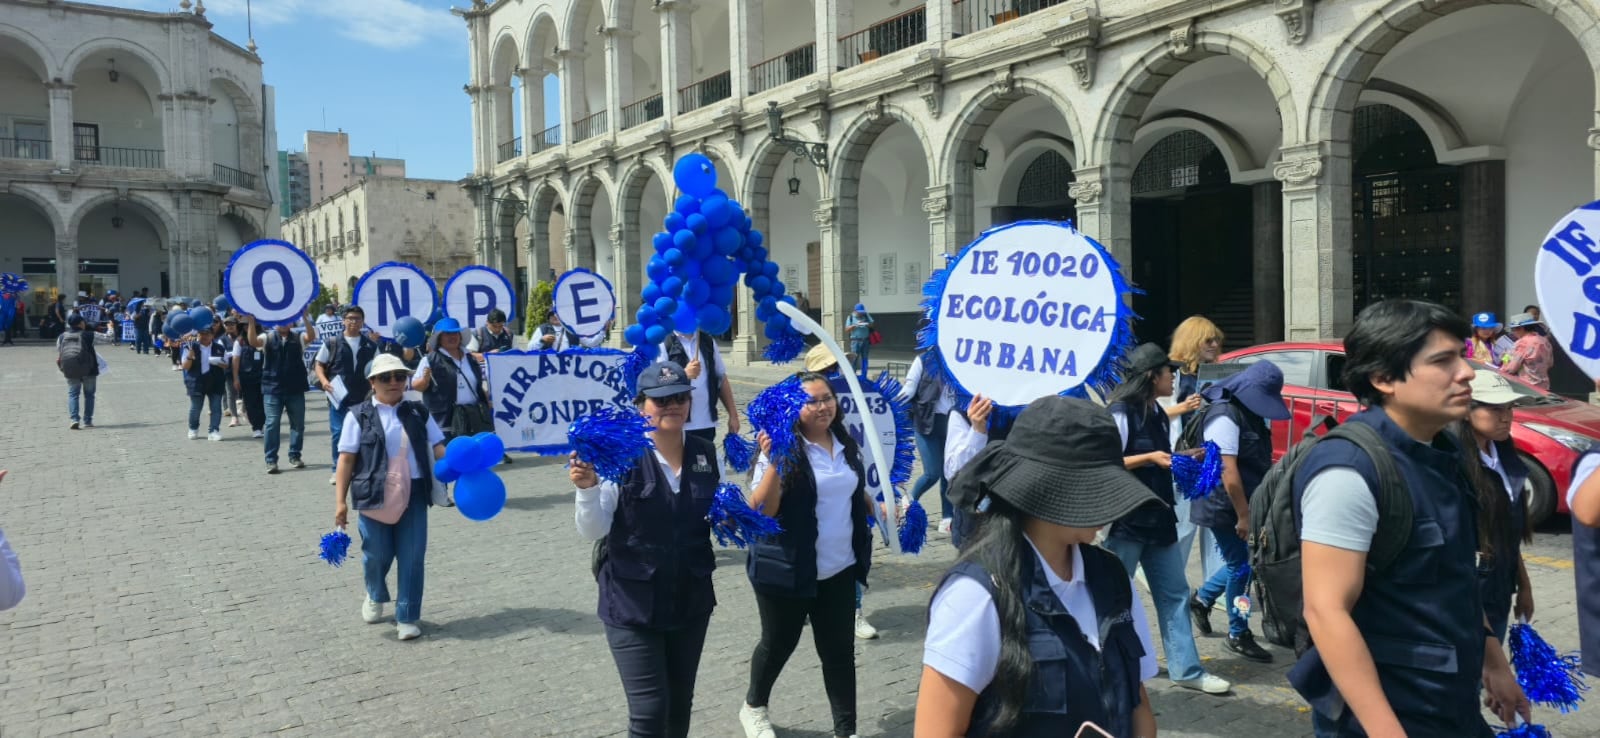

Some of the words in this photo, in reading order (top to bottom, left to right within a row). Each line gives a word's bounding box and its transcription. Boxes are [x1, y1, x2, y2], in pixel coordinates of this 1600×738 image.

[252, 260, 295, 311] O
[970, 250, 999, 275] IE
[1006, 250, 1099, 279] 40020
[377, 279, 410, 326] N
[465, 284, 497, 328] P
[569, 280, 601, 326] E
[946, 291, 1107, 333] ECOLÓGICA
[955, 337, 1078, 377] URBANA
[495, 354, 633, 428] MIRAFLORE
